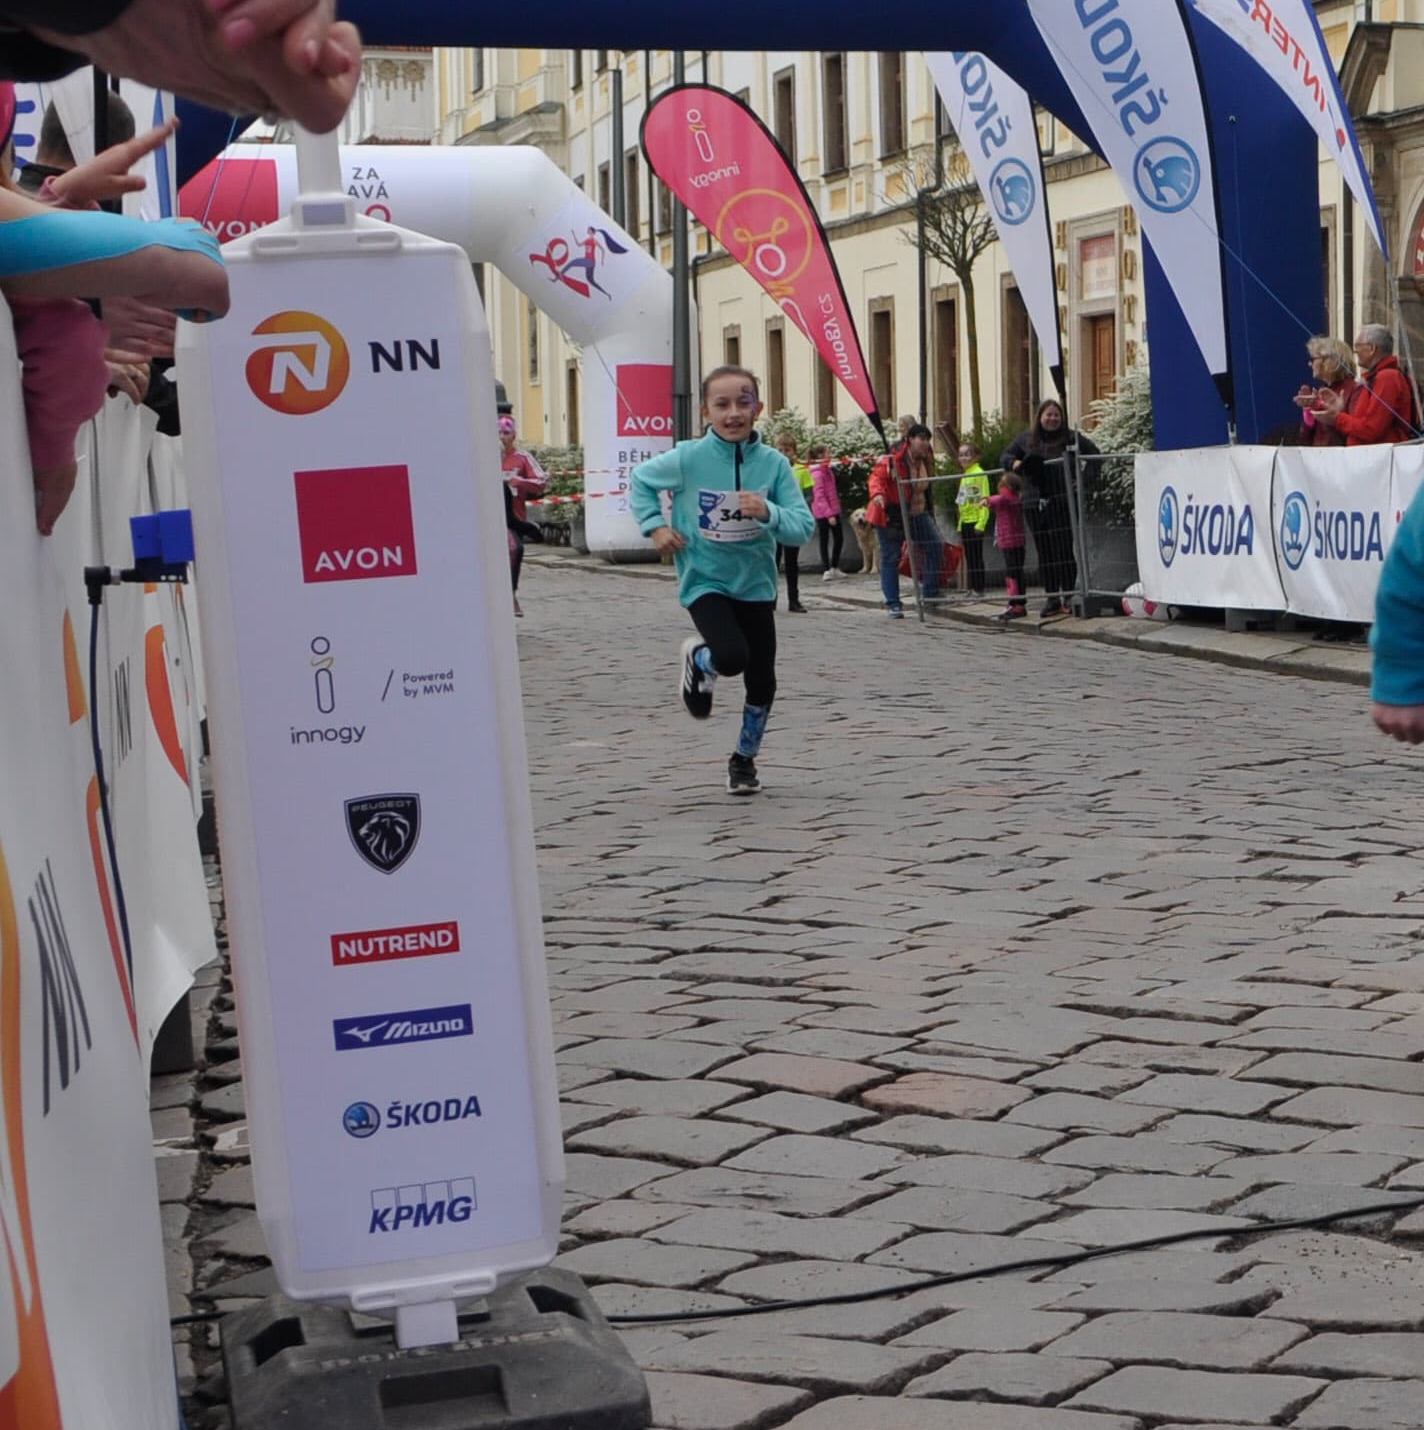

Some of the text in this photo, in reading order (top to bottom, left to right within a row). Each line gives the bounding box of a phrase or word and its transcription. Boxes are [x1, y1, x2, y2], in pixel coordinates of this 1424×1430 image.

[367, 338, 440, 373] NN
[1180, 494, 1255, 557] ŠKODA
[1313, 501, 1384, 562] ŠKODA
[314, 545, 404, 573] AVON
[402, 669, 454, 684] Powered
[403, 682, 455, 699] by MVM
[289, 725, 367, 745] innogy
[351, 799, 413, 813] PEUGEOT
[338, 928, 453, 959] NUTREND
[386, 1095, 483, 1130] ŠKODA
[368, 1195, 474, 1235] KPMG
